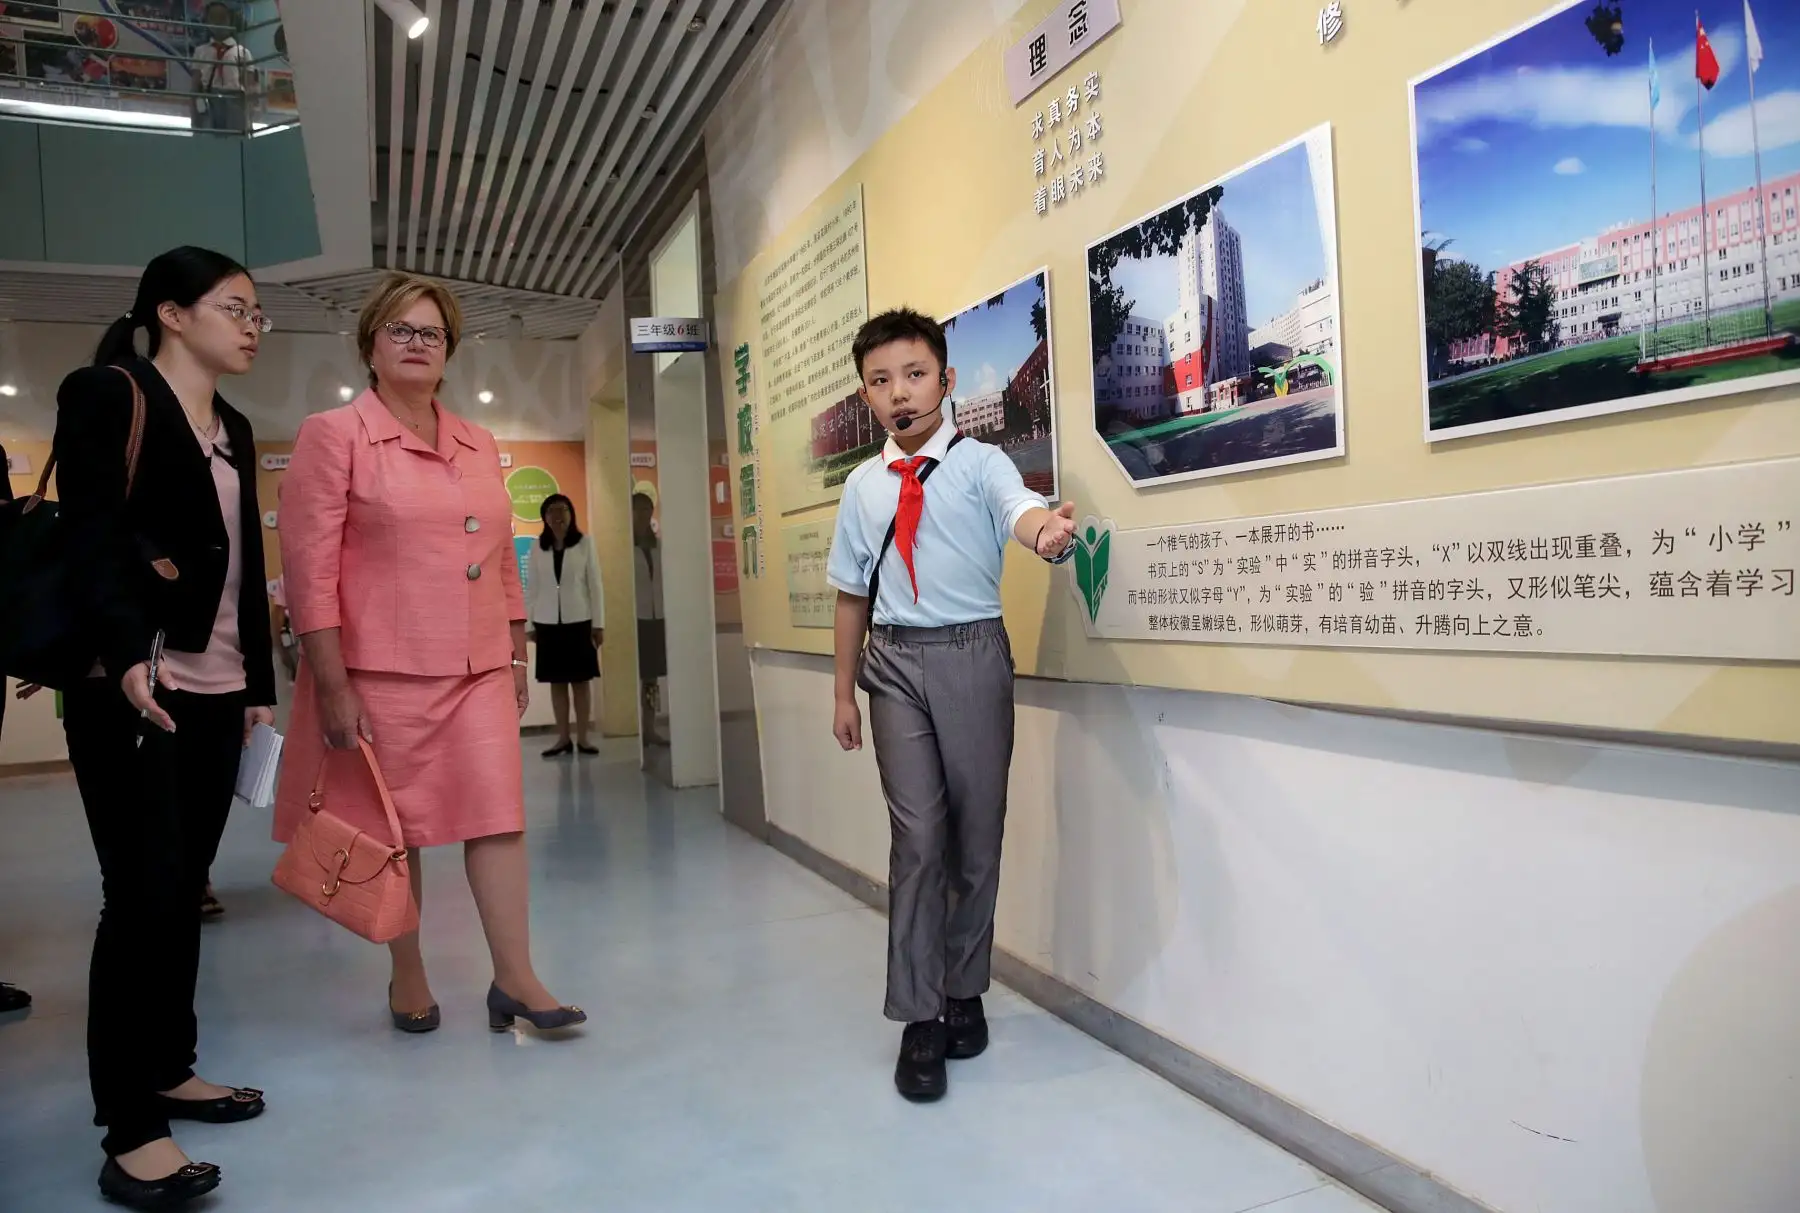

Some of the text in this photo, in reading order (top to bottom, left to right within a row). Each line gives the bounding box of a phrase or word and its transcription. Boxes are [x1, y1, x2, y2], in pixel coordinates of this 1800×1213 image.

[1028, 0, 1088, 76] 理念
[1316, 0, 1343, 45] 修
[1031, 71, 1101, 139] 求真务实
[1032, 111, 1103, 177] 育人为本
[1033, 151, 1105, 216] 着眼未来
[637, 323, 700, 336] 三年级6班
